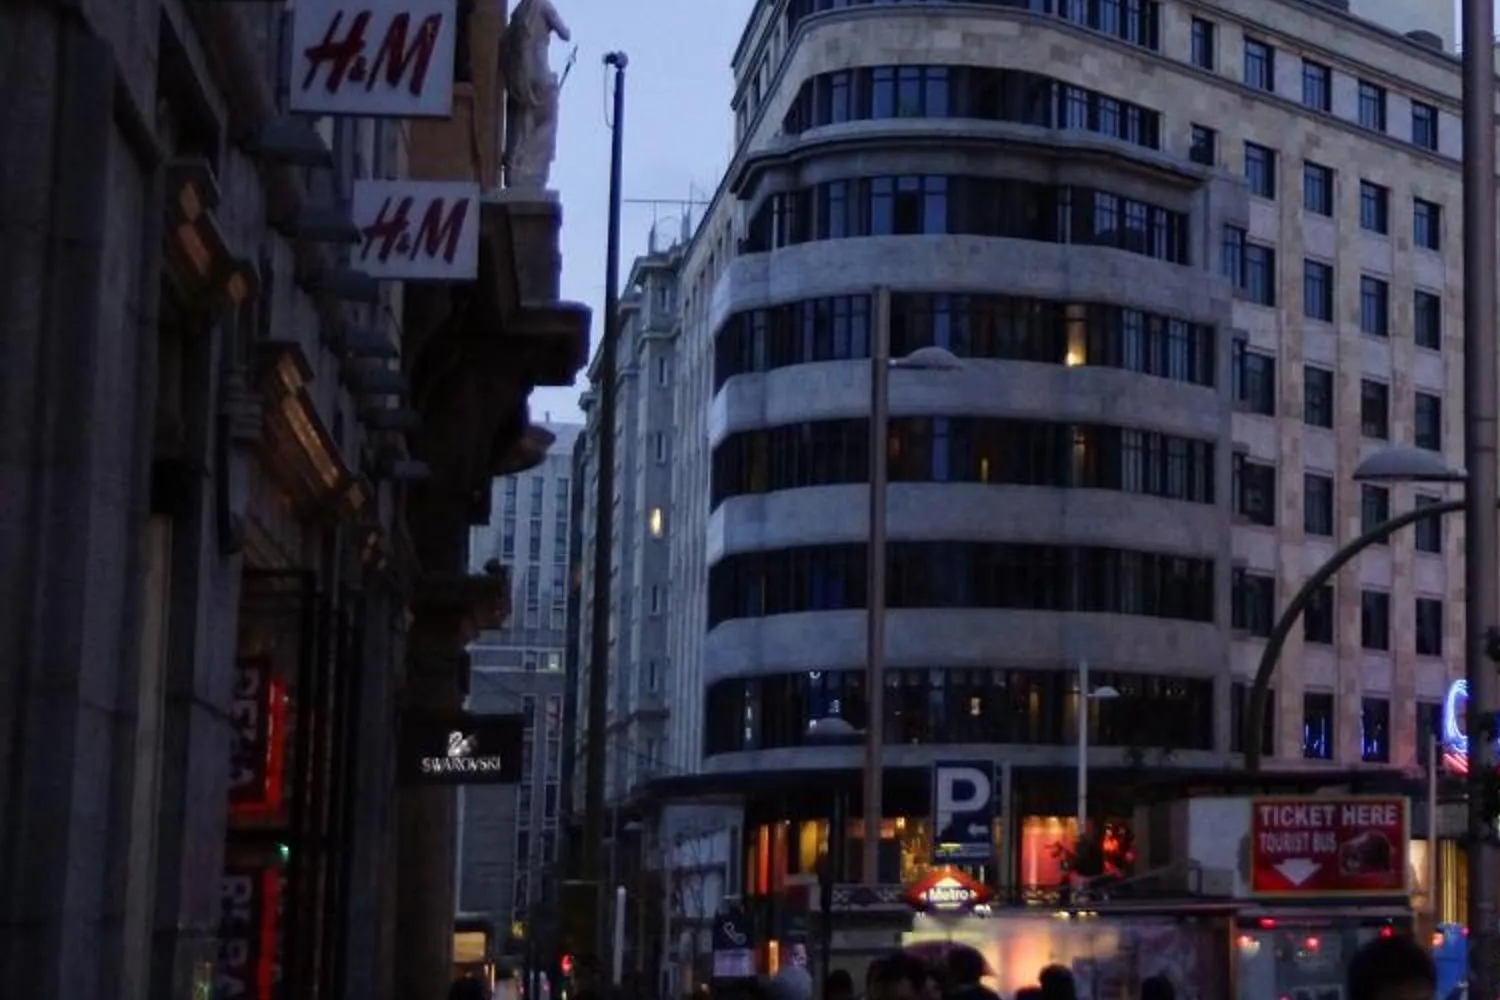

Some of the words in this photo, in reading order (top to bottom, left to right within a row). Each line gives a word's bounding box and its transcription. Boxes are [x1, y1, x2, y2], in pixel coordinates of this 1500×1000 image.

[303, 9, 442, 97] H&M
[359, 197, 470, 266] H&M
[421, 756, 501, 773] SWAROVSKI
[937, 767, 991, 838] P
[1259, 804, 1336, 827] TICKET
[1341, 804, 1398, 826] HERE
[1259, 832, 1309, 854] TOURIST
[1312, 831, 1338, 854] BUS
[929, 888, 969, 902] Metro
